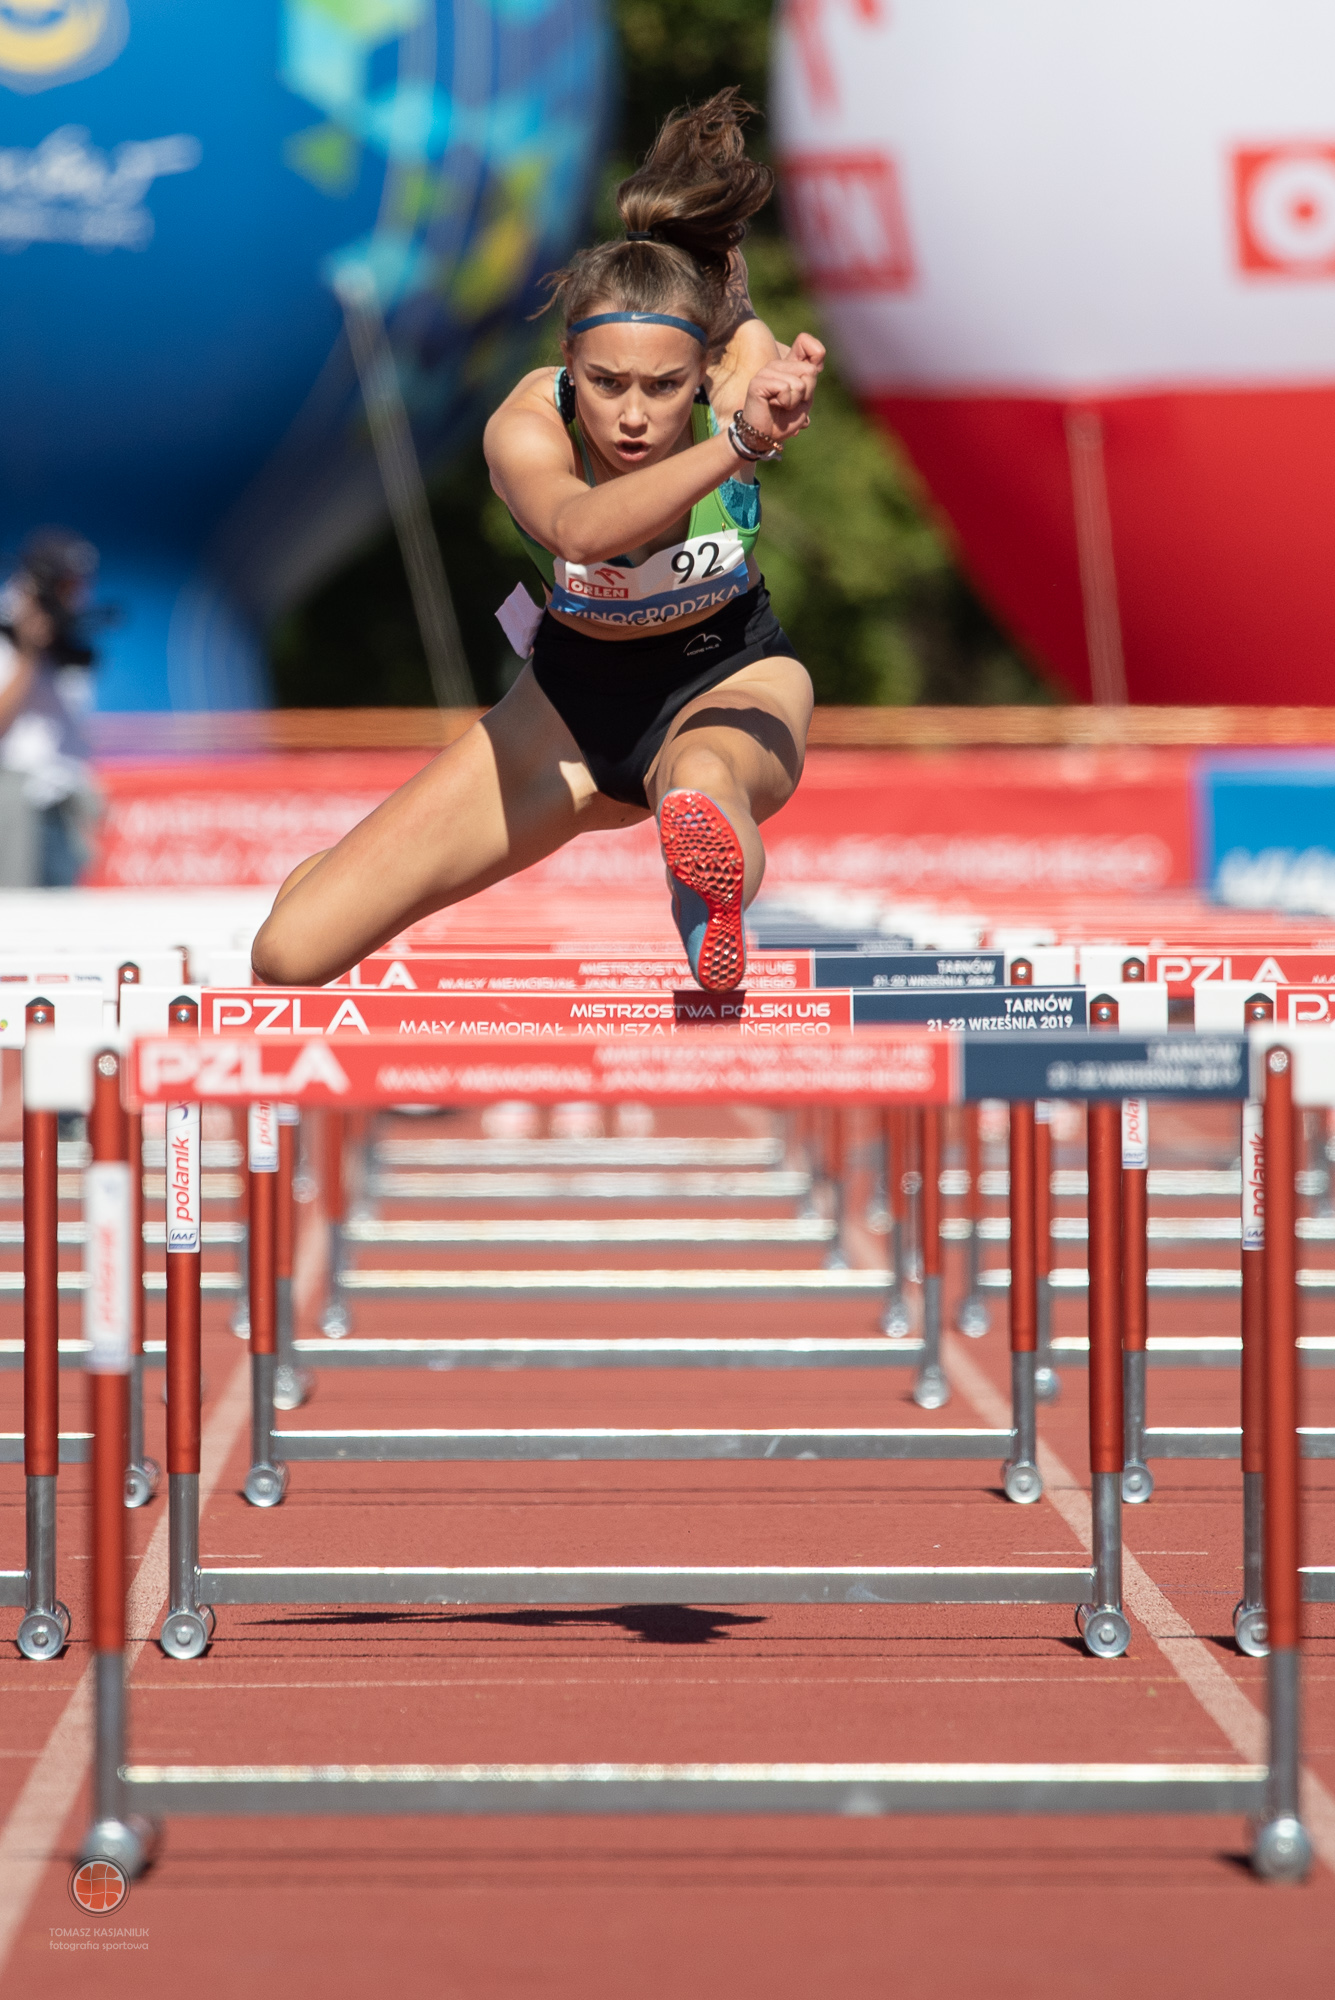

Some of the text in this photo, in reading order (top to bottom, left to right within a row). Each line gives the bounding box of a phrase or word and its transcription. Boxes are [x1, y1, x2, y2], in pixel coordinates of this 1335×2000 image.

[670, 541, 724, 584] 92
[570, 580, 625, 597] ORLEN
[570, 1003, 831, 1018] MISTRZOSTWA POLSKI U16
[1005, 995, 1073, 1012] TARNÓW
[212, 998, 370, 1035] PZLA
[927, 1014, 1073, 1032] 21-22 WRZEŚNIA 2019
[399, 1020, 455, 1035] MAŁY
[459, 1021, 566, 1037] MEMORIAŁ
[570, 1023, 666, 1037] JANUSZA
[172, 1135, 194, 1223] polanik
[171, 1233, 196, 1241] IAAF
